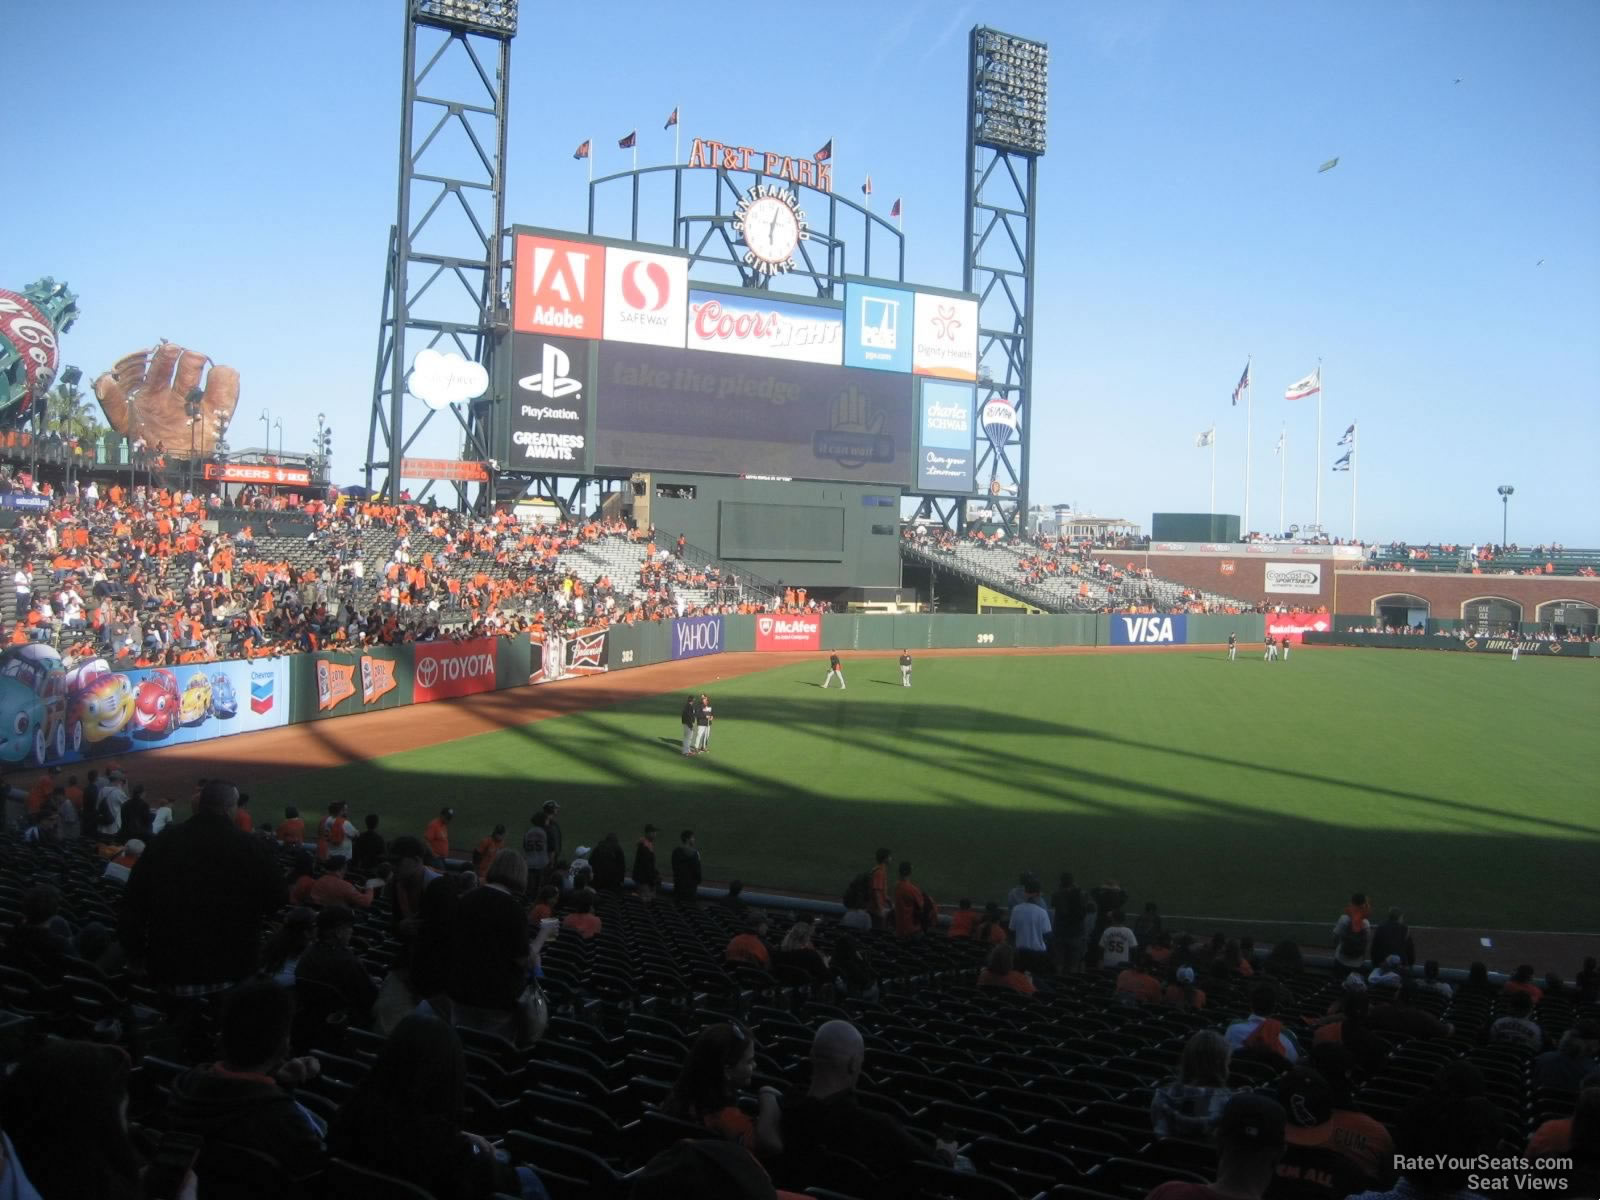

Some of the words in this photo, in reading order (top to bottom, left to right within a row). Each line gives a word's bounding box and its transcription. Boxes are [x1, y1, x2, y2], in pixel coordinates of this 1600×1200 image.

[688, 138, 755, 171] AT&T
[764, 152, 832, 192] PARK
[733, 196, 751, 231] SAN
[749, 184, 810, 240] FRANCISCO
[744, 252, 798, 276] GIANTS
[533, 305, 584, 329] Adobe
[620, 312, 668, 326] SAFEWAY
[693, 300, 777, 340] Coors
[917, 343, 945, 360] Dignity
[947, 348, 972, 359] Health
[612, 361, 670, 389] take
[673, 367, 714, 393] the
[716, 373, 801, 405] pledge
[521, 405, 579, 420] PlayStation
[927, 418, 967, 432] SCHWAB
[513, 431, 584, 448] GREATNESS
[775, 620, 816, 633] McAfee
[1122, 617, 1173, 643] VISA
[676, 619, 721, 655] YAHOO!
[977, 633, 994, 643] 399
[251, 671, 275, 680] Chevron
[441, 653, 494, 681] TOYOTA
[1108, 940, 1124, 953] 55
